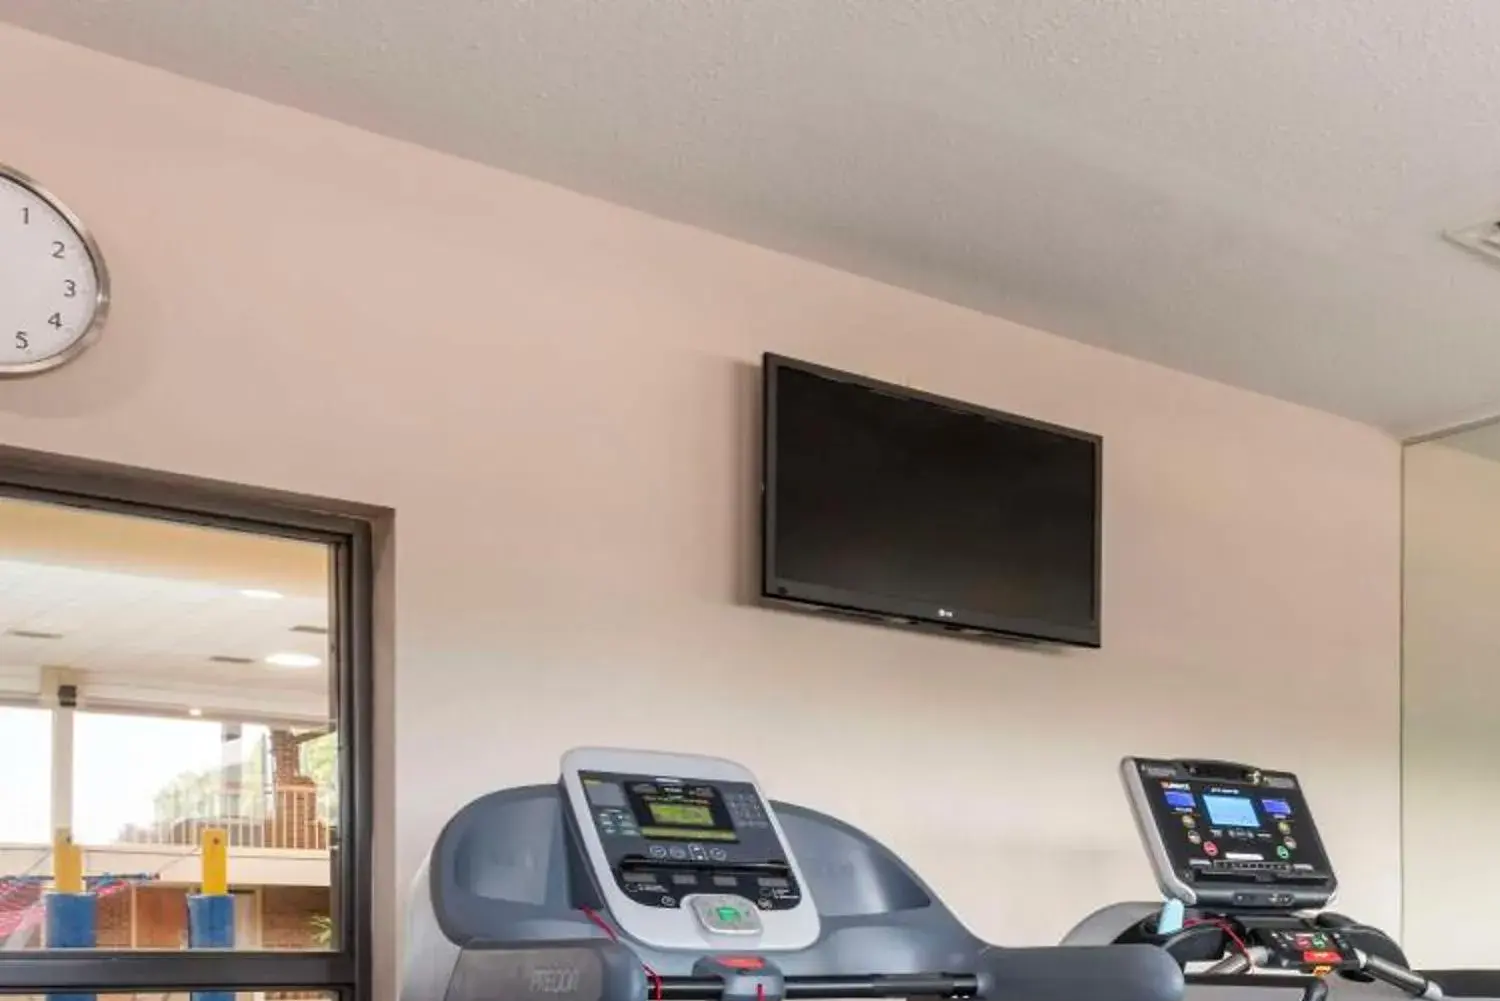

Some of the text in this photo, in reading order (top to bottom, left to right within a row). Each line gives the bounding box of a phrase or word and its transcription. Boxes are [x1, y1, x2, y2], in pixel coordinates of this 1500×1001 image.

[21, 207, 30, 225] 1
[51, 241, 66, 259] 2
[63, 279, 77, 298] 3
[47, 312, 63, 330] 4
[15, 331, 30, 350] 5
